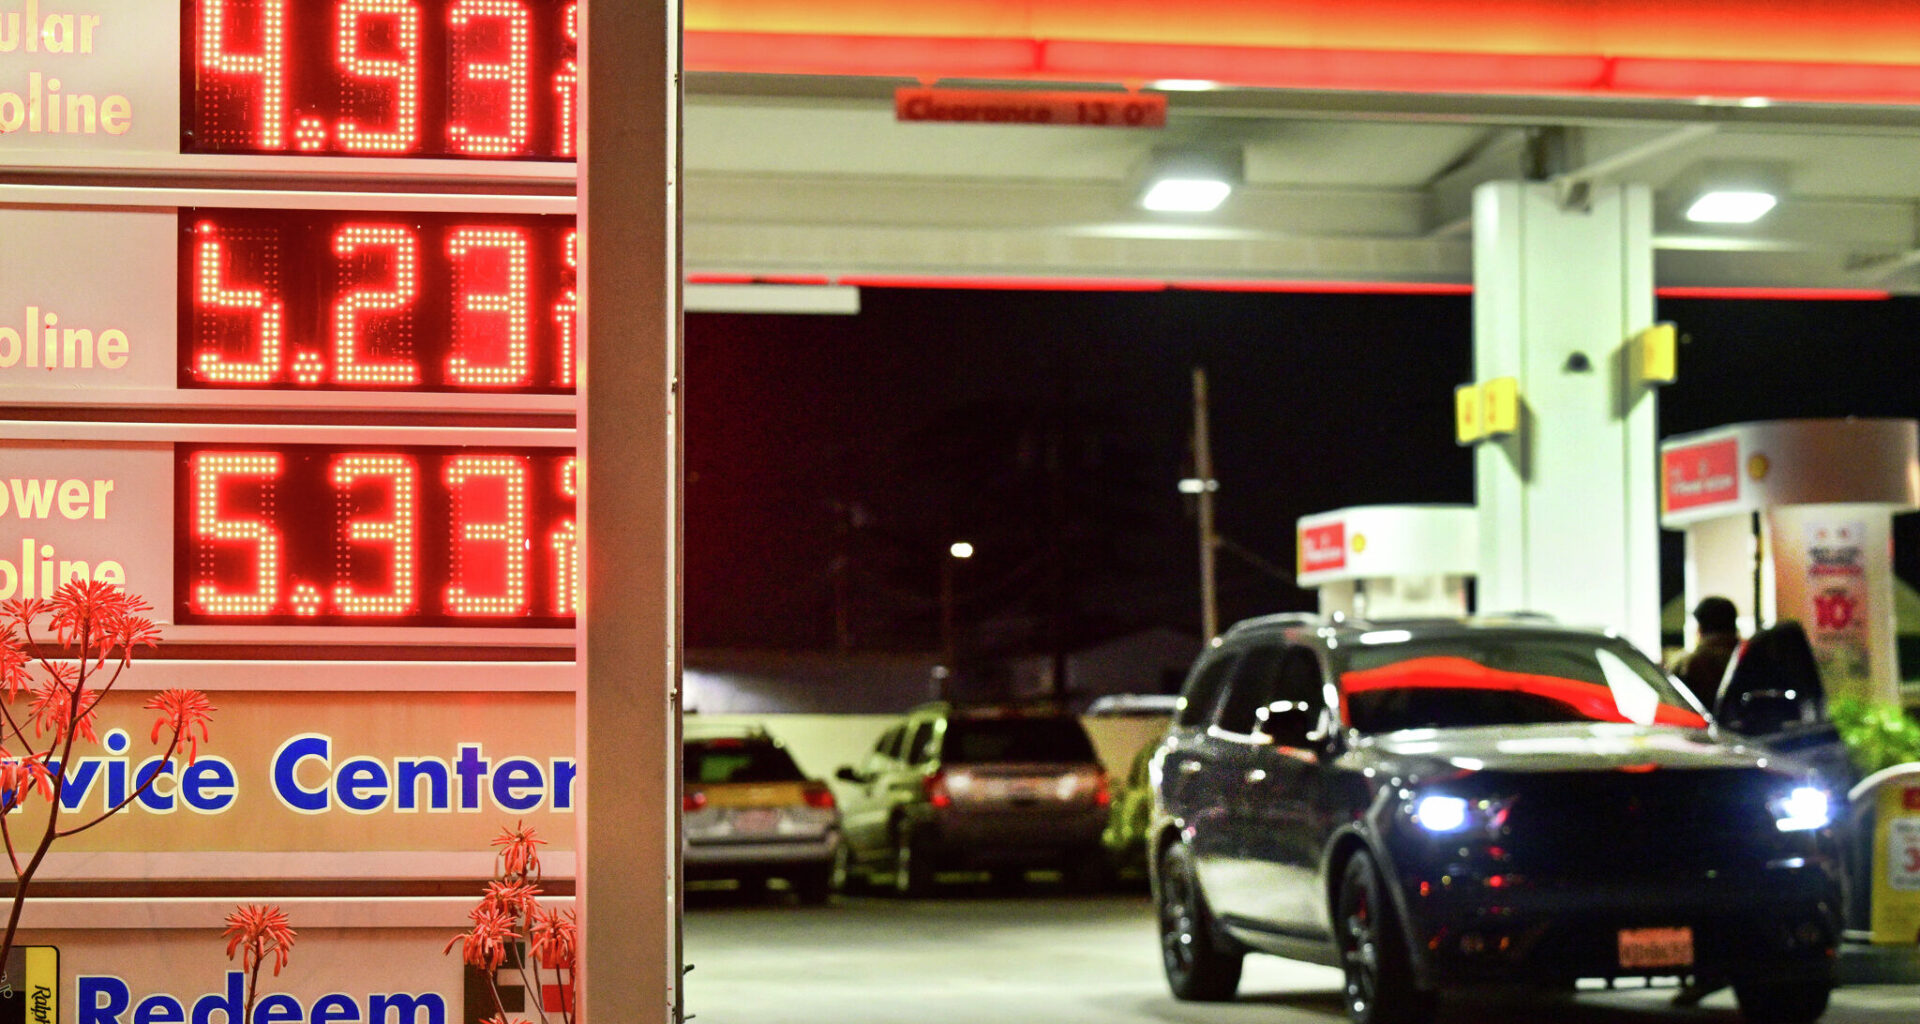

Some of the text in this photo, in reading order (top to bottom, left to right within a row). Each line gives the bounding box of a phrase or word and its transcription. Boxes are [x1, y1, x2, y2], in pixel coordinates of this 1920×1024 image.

[0, 0, 101, 53] ular
[0, 71, 132, 135] oline
[200, 0, 531, 154] 4.93
[0, 306, 130, 369] oline
[197, 221, 529, 387] 5.23
[197, 454, 526, 616] 5.33
[271, 733, 577, 814] Center
[76, 970, 448, 1024] Redeem
